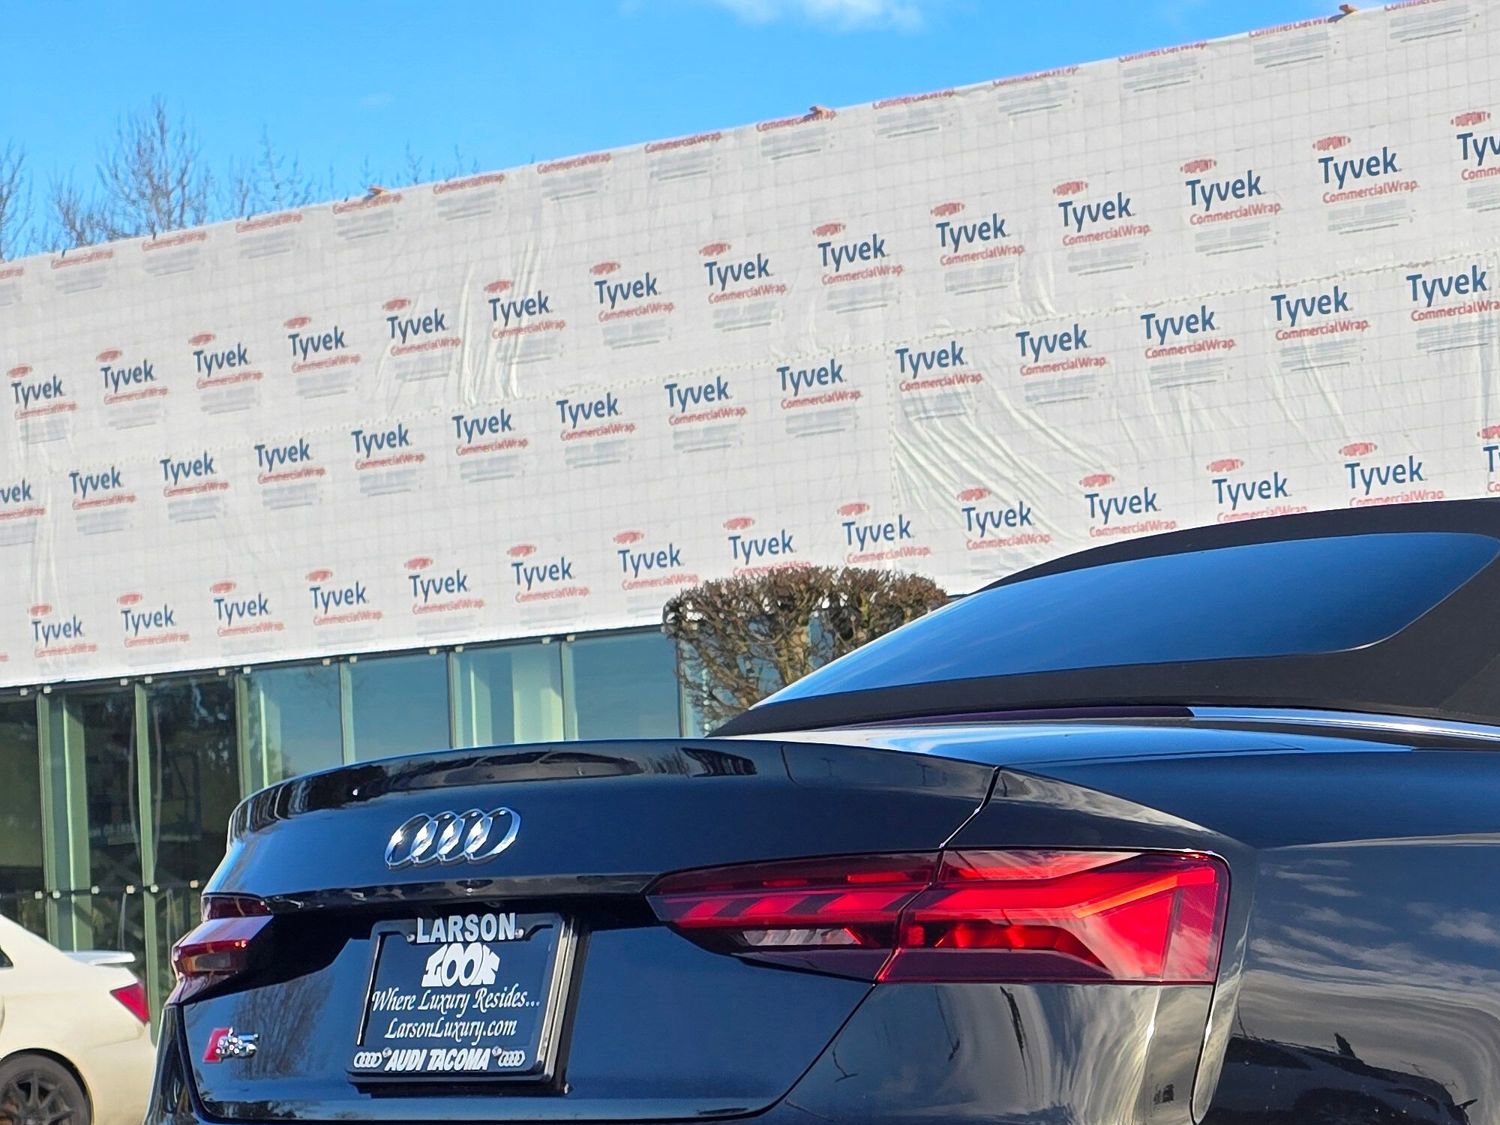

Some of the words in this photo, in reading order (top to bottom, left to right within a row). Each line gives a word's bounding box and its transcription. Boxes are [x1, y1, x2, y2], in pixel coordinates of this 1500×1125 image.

[1318, 147, 1401, 189] Tyvek
[1186, 170, 1262, 211] Tyvek
[1323, 181, 1419, 204] CommercialWrap
[1058, 192, 1131, 232] Tyvek
[936, 213, 1009, 252] Tyvek
[818, 234, 888, 272] Tyvek
[704, 254, 769, 291] Tyvek
[1406, 265, 1487, 307] Tyvek
[594, 272, 657, 309] Tyvek
[1271, 286, 1348, 327] Tyvek
[387, 308, 445, 343] Tyvek
[489, 291, 549, 326] Tyvek
[1141, 305, 1215, 345] Tyvek
[288, 326, 345, 360] Tyvek
[1016, 324, 1087, 362] Tyvek
[1275, 320, 1371, 341] CommercialWrap
[101, 360, 153, 392] Tyvek
[193, 343, 248, 377] Tyvek
[895, 341, 964, 379] Tyvek
[12, 376, 62, 408] Tyvek
[664, 376, 729, 413] Tyvek
[777, 359, 843, 396] Tyvek
[452, 409, 512, 443] Tyvek
[556, 393, 618, 428] Tyvek
[254, 438, 310, 472] Tyvek
[351, 424, 409, 458] Tyvek
[69, 467, 121, 498] Tyvek
[160, 452, 214, 485] Tyvek
[1345, 456, 1423, 495] Tyvek
[0, 479, 32, 504] vek
[1085, 487, 1157, 524] Tyvek
[1212, 472, 1288, 510] Tyvek
[842, 514, 911, 551] Tyvek
[962, 501, 1032, 537] Tyvek
[618, 544, 680, 578] Tyvek
[728, 530, 793, 564] Tyvek
[409, 570, 467, 602] Tyvek
[512, 557, 572, 589] Tyvek
[214, 594, 268, 625] Tyvek
[310, 582, 366, 614] Tyvek
[32, 616, 82, 645] Tyvek
[121, 605, 173, 635] Tyvek
[416, 913, 516, 943] LARSON
[372, 987, 416, 1012] Where
[418, 990, 470, 1018] Luxury
[384, 1017, 517, 1046] LarsonLuxury.com
[384, 1049, 425, 1071] AUDI
[427, 1048, 491, 1071] TACOMA
